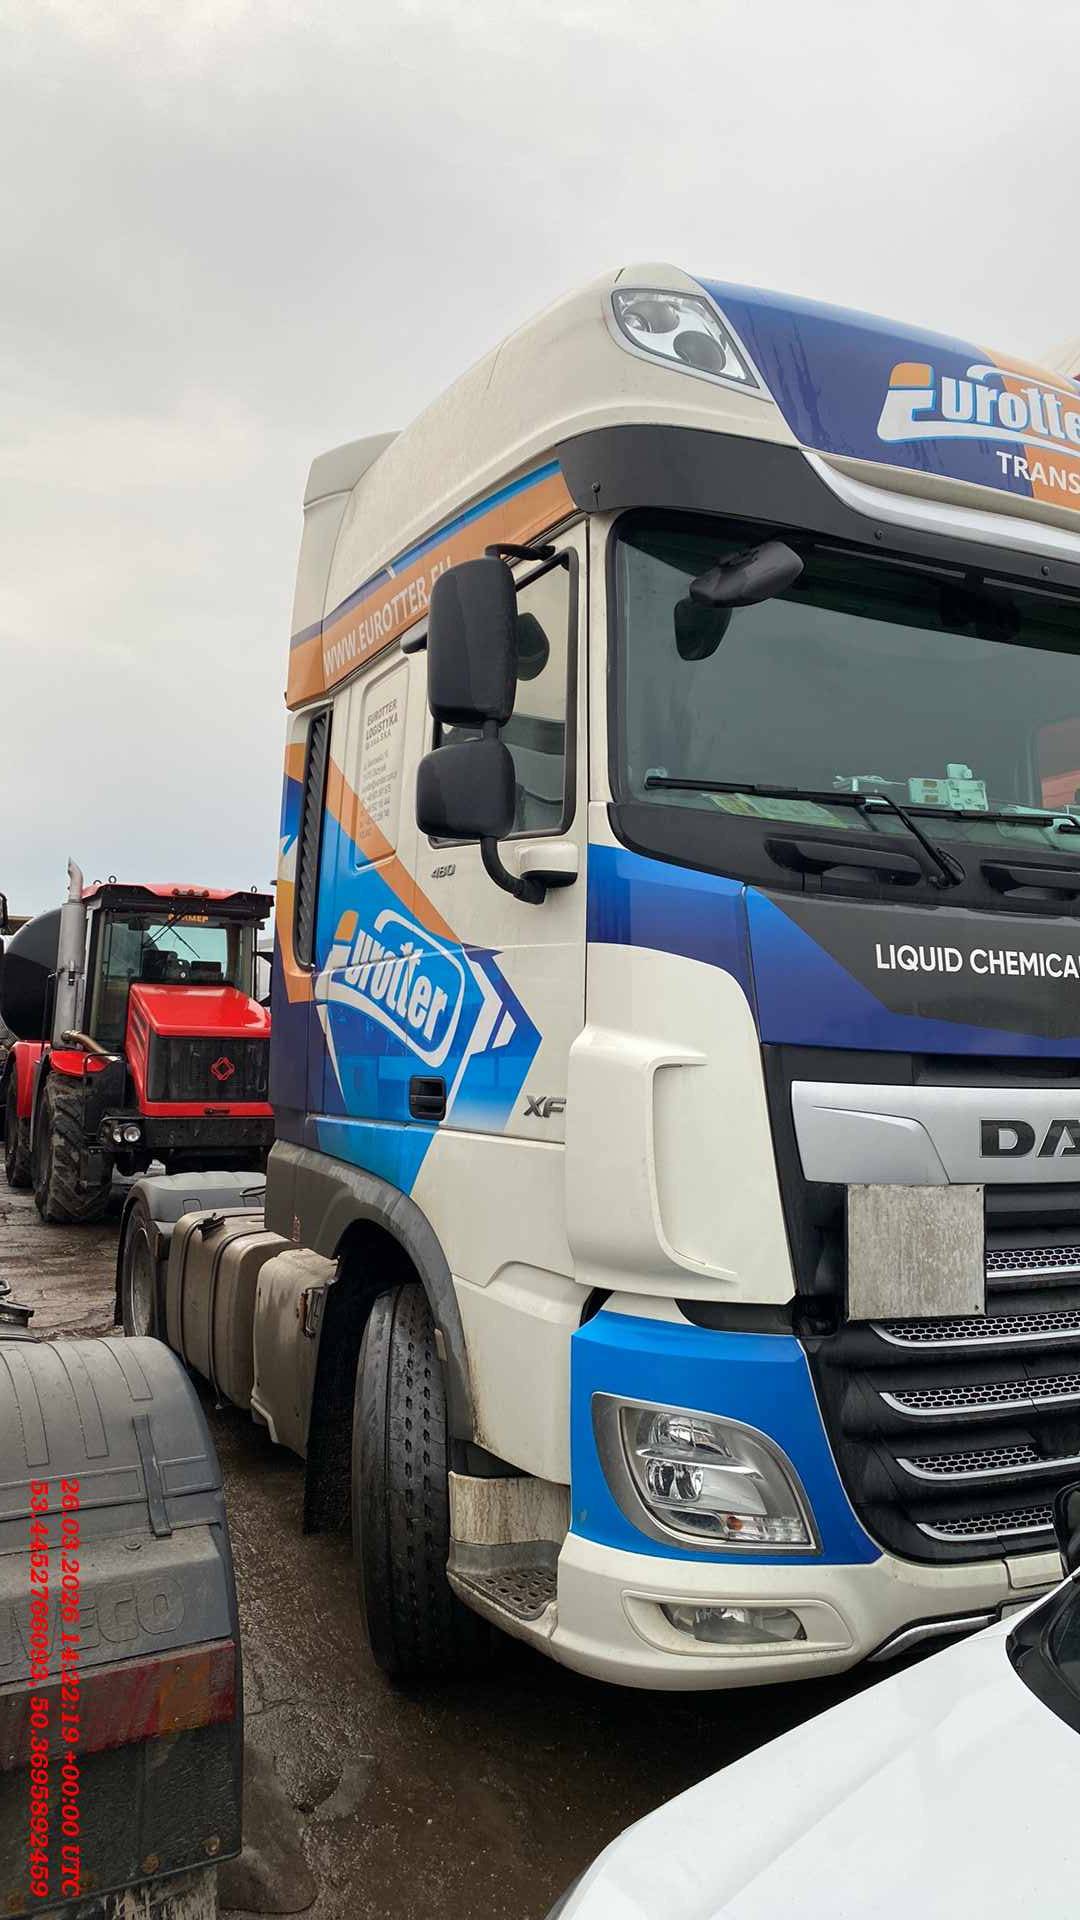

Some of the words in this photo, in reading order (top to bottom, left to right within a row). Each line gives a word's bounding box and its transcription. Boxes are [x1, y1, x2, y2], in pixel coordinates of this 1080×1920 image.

[431, 864, 456, 880] 480
[315, 909, 449, 1042] Eurotter
[875, 944, 964, 972] LIQUID
[969, 949, 1080, 979] CHEMICA
[523, 1095, 568, 1118] XF
[980, 1119, 1080, 1158] DA
